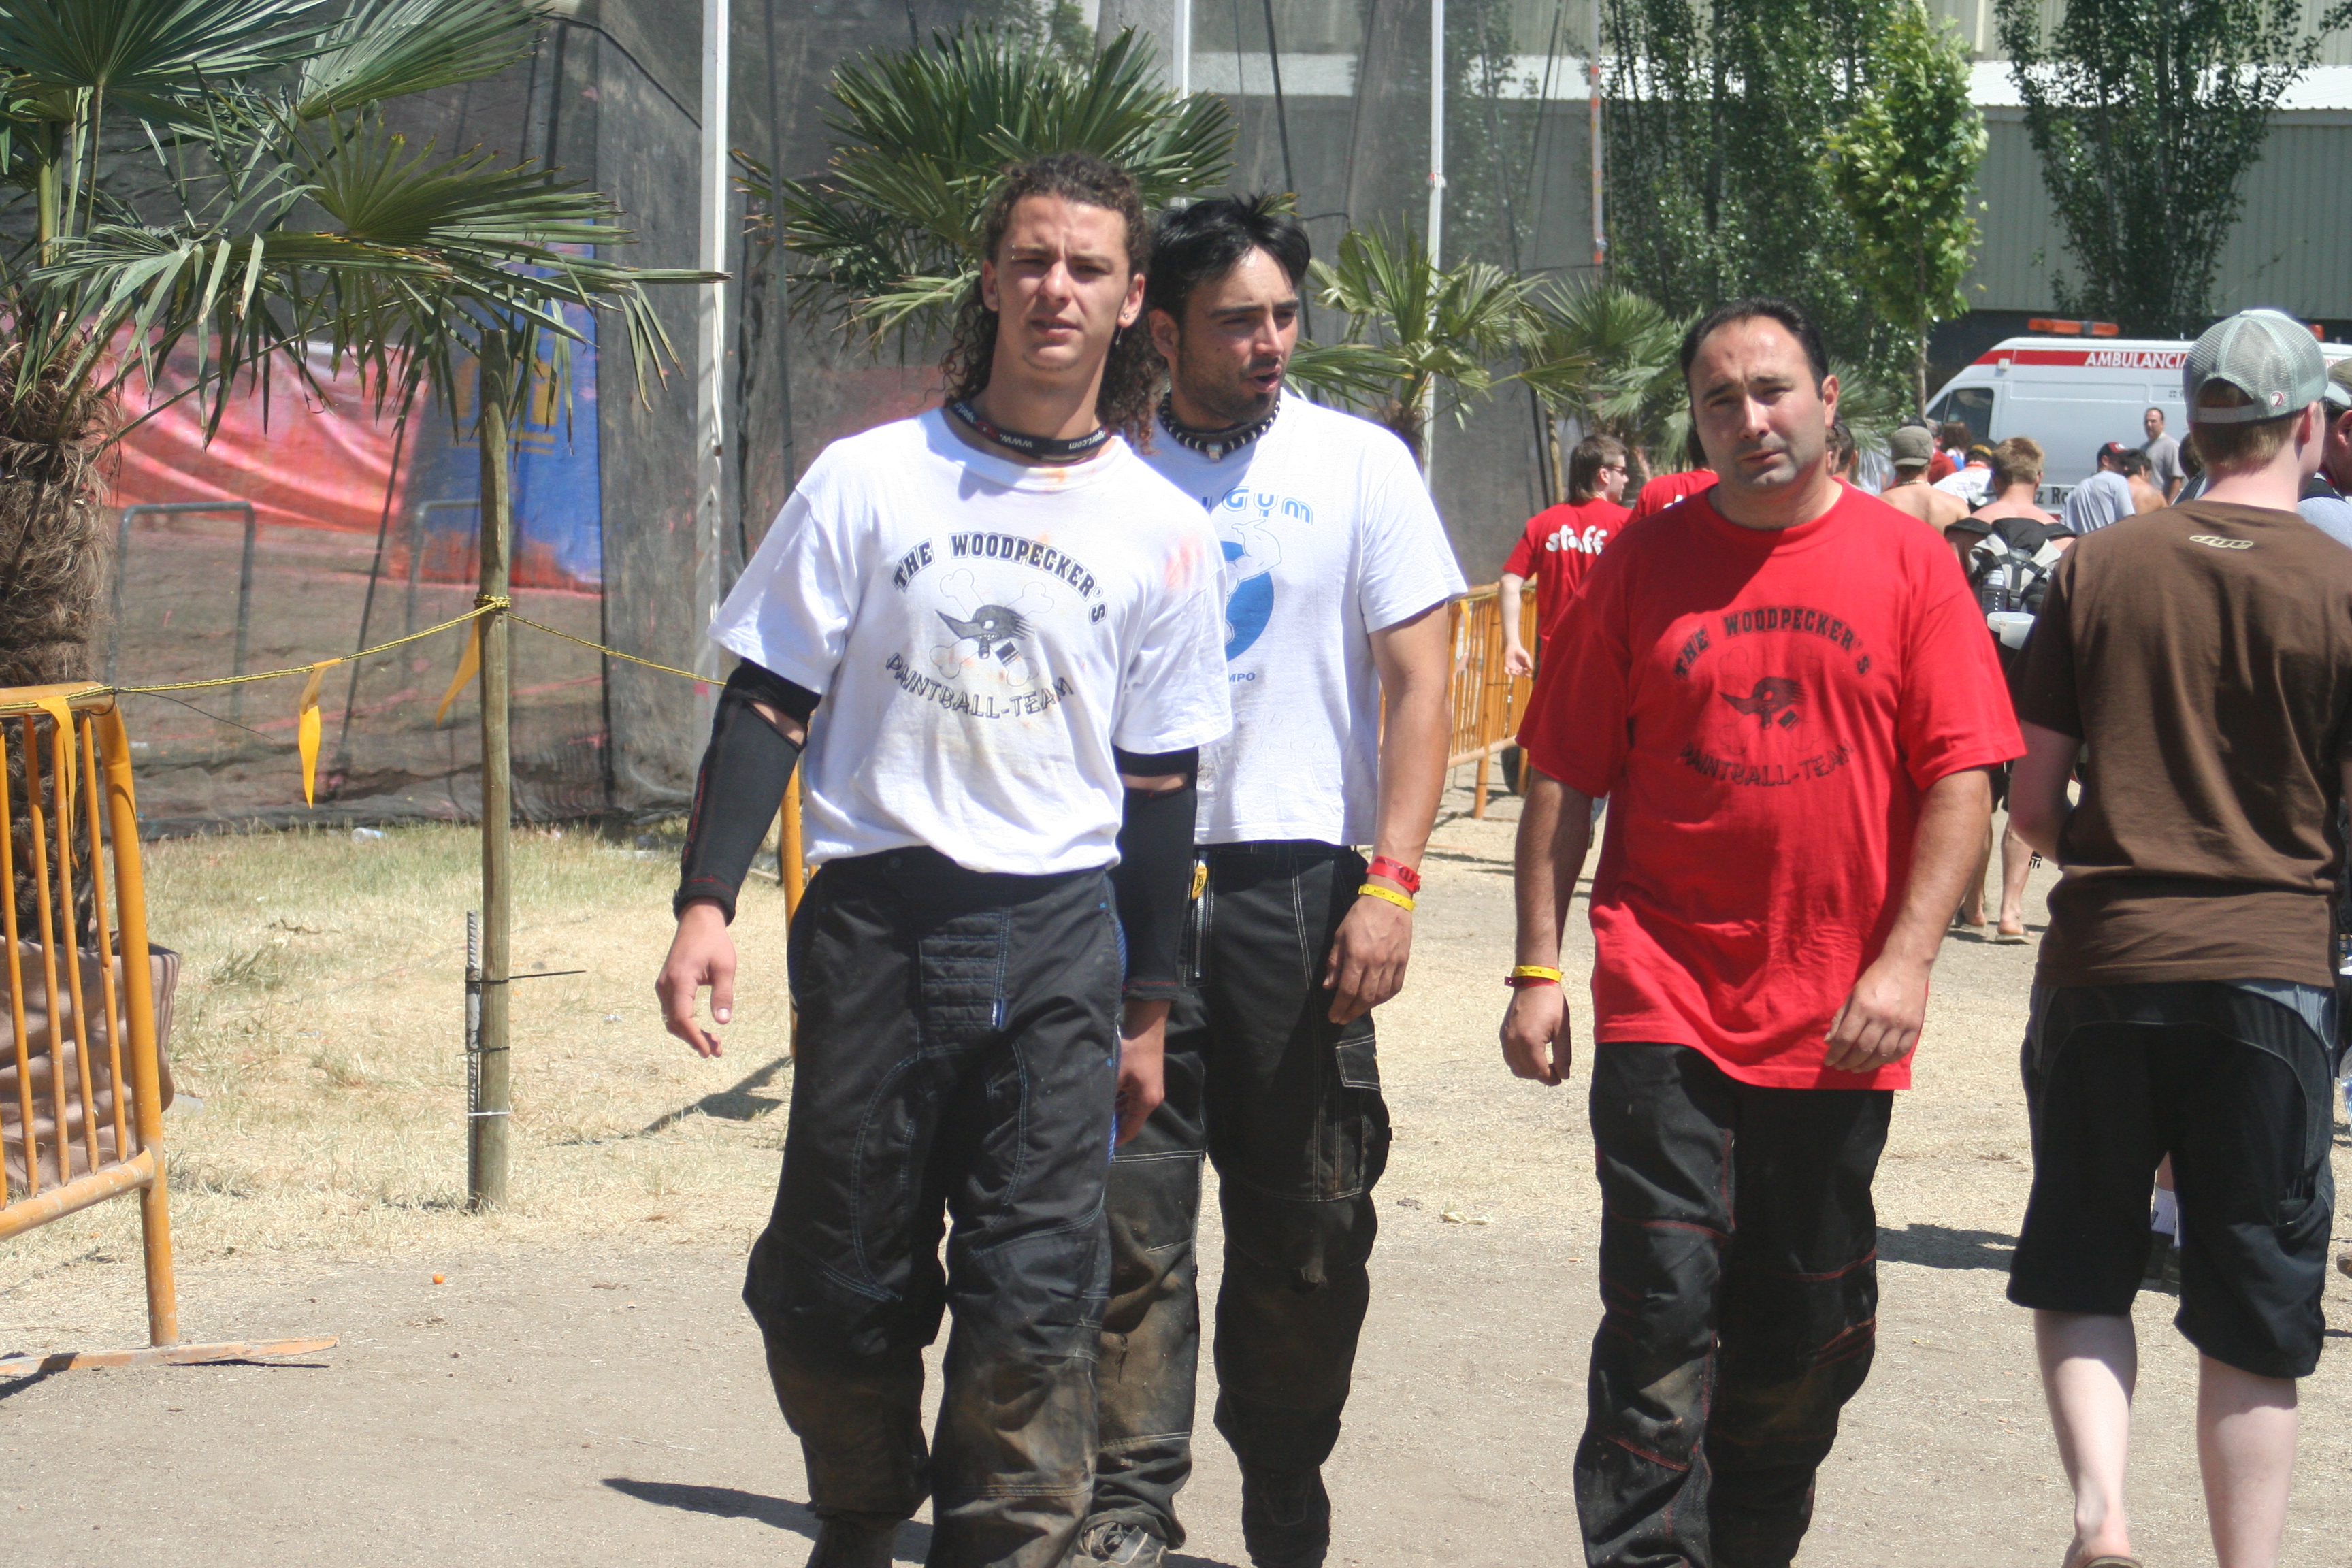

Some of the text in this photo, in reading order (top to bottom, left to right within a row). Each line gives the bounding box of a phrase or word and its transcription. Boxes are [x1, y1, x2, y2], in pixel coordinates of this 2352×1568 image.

[1545, 524, 1608, 555] staff
[892, 531, 1107, 625] THE WOODPECKER'S
[1673, 606, 1870, 679] THE WOODPECKER'S
